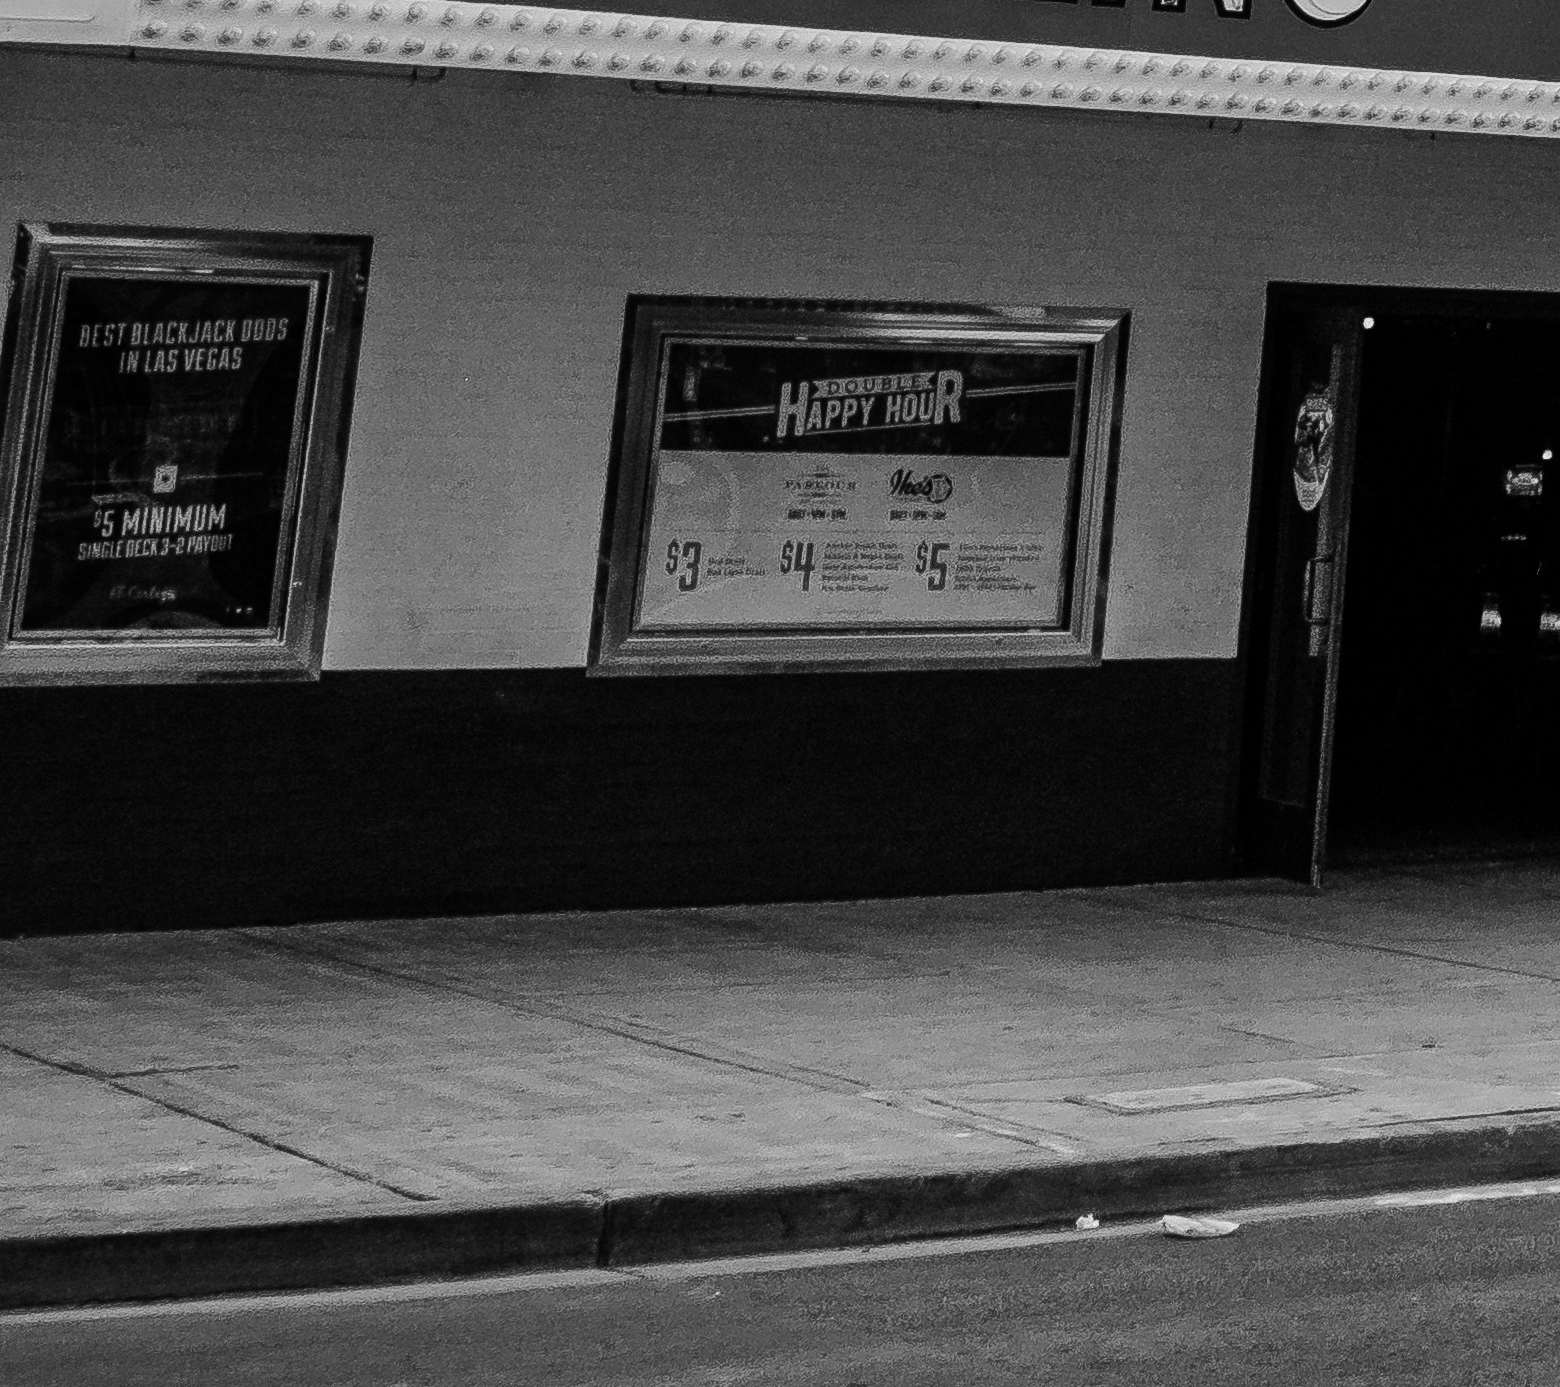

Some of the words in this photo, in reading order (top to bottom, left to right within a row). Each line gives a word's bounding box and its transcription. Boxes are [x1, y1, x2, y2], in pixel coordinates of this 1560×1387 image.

[79, 323, 127, 348] BEST
[130, 320, 235, 346] BLACKJACK
[241, 318, 288, 342] ODDS
[118, 350, 138, 373] IN
[144, 349, 179, 373] LAS
[184, 347, 243, 371] VEGAS
[826, 376, 925, 395] DOUBLE
[776, 381, 875, 437] HAPPY
[885, 369, 963, 425] HOUR
[93, 509, 115, 537] $5
[122, 504, 227, 536] MINIMUM
[78, 540, 124, 561] SINGLE
[125, 538, 158, 558] DECK
[187, 533, 233, 556] PAYOUT
[665, 538, 702, 592] $3
[780, 538, 815, 592] $4
[914, 538, 950, 592] $5
